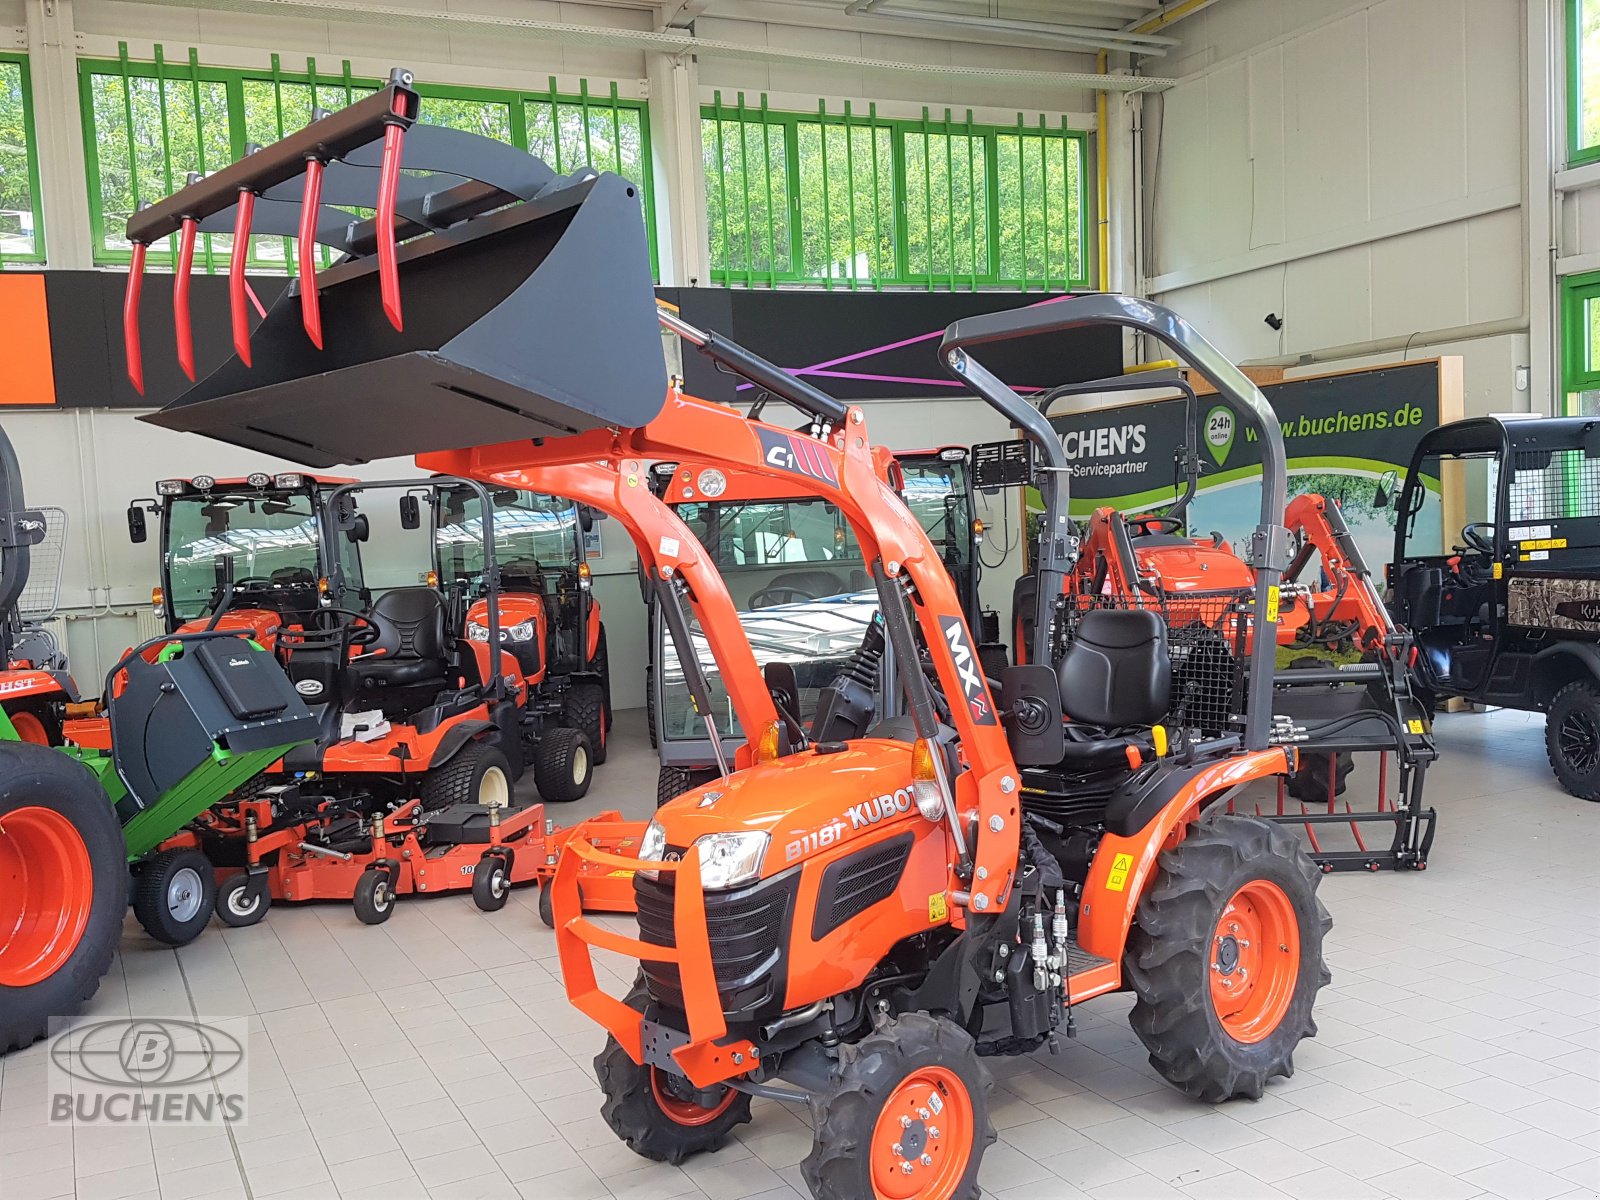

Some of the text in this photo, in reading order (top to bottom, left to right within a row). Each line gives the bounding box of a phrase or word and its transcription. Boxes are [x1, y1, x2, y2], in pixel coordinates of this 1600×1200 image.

[1210, 416, 1231, 431] 24h
[1245, 403, 1423, 441] ww.buchens.de
[1034, 424, 1147, 463] CHEN'S
[1210, 432, 1228, 440] online
[766, 446, 794, 469] C1
[1067, 460, 1148, 478] -Servicepartner
[945, 621, 981, 697] MX
[848, 785, 919, 830] KUBOT
[461, 865, 475, 875] 10
